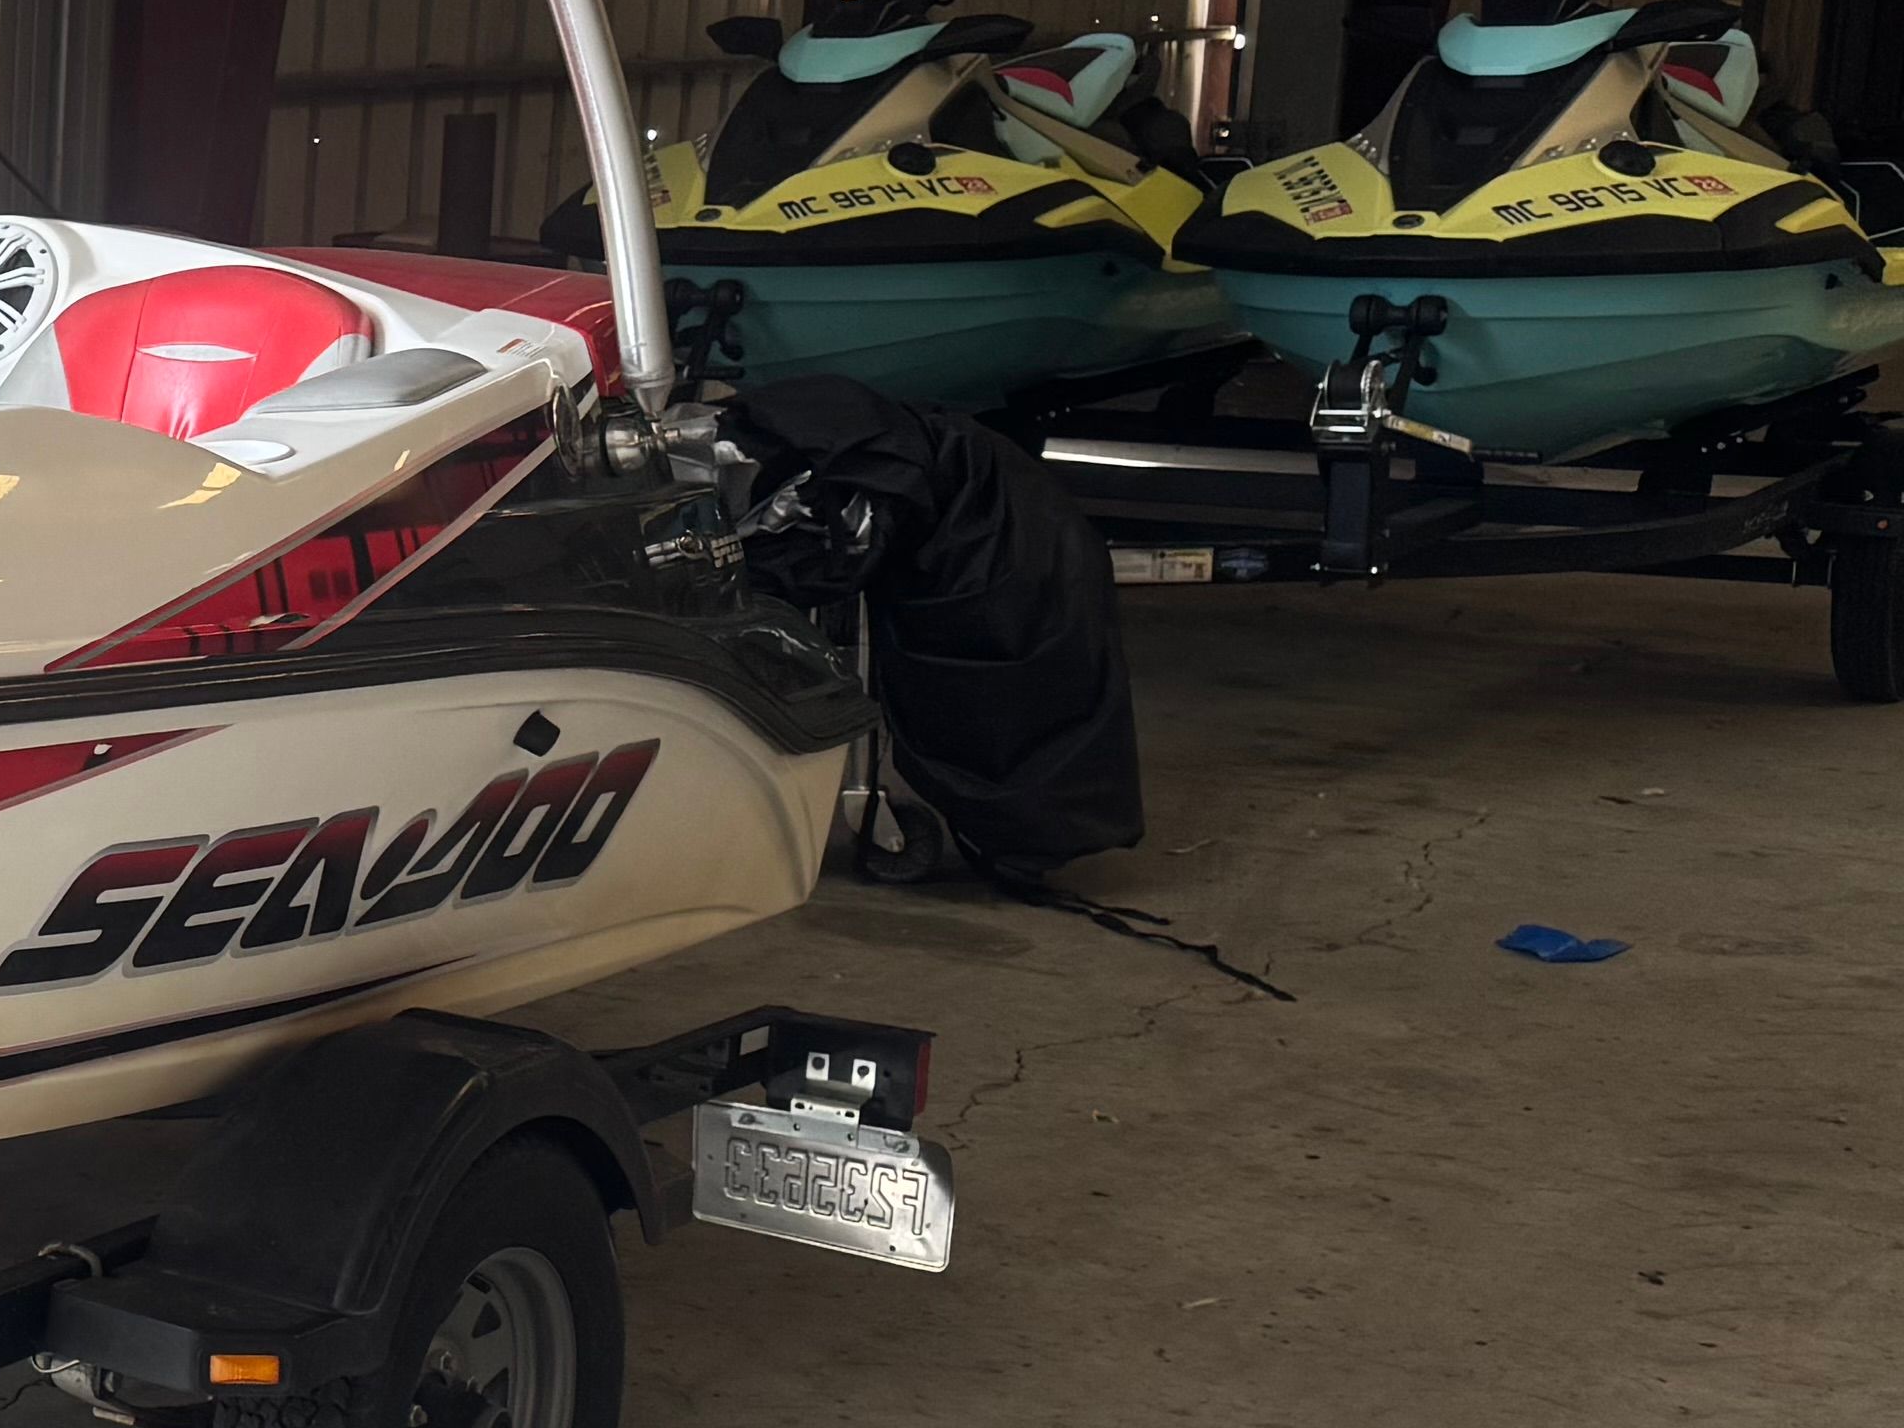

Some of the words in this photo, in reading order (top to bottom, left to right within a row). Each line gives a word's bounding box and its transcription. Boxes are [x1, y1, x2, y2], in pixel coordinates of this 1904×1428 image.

[778, 196, 828, 220] MC
[829, 182, 916, 209] 9674
[916, 176, 964, 197] VC
[1492, 199, 1553, 226] MC
[1548, 183, 1647, 212] 9675
[1642, 177, 1698, 198] VC
